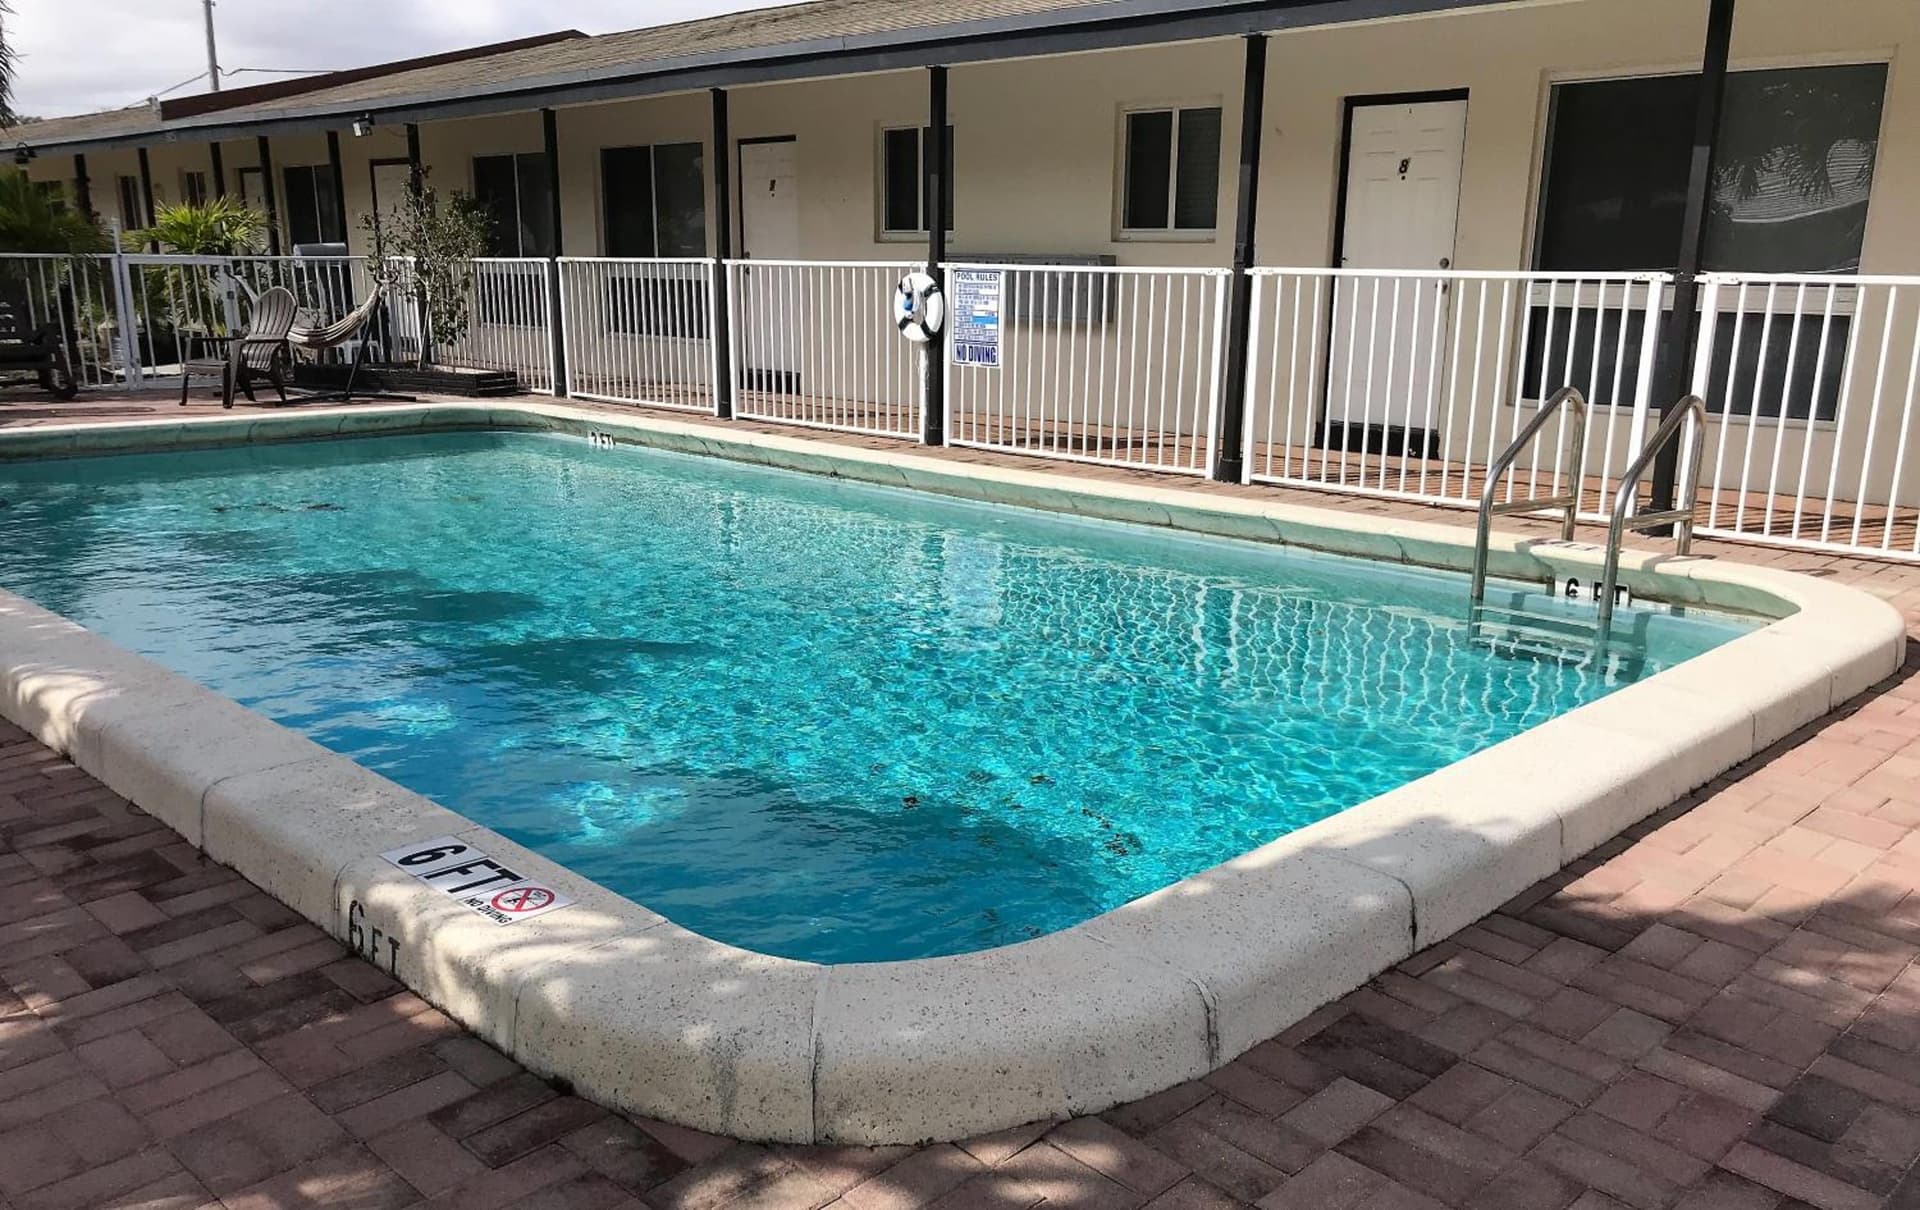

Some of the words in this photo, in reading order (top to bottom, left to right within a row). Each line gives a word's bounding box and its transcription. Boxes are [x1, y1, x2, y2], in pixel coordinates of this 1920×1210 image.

[1399, 158, 1410, 174] 8
[956, 271, 974, 281] POOL
[976, 272, 998, 281] RULES
[956, 344, 967, 361] NO
[968, 345, 996, 364] DIVING
[1565, 577, 1580, 598] 6
[398, 844, 468, 867] 6
[423, 858, 524, 894] FT
[464, 897, 484, 907] NO
[477, 904, 513, 924] DIVING
[350, 899, 365, 951] 6
[371, 926, 401, 976] FT
